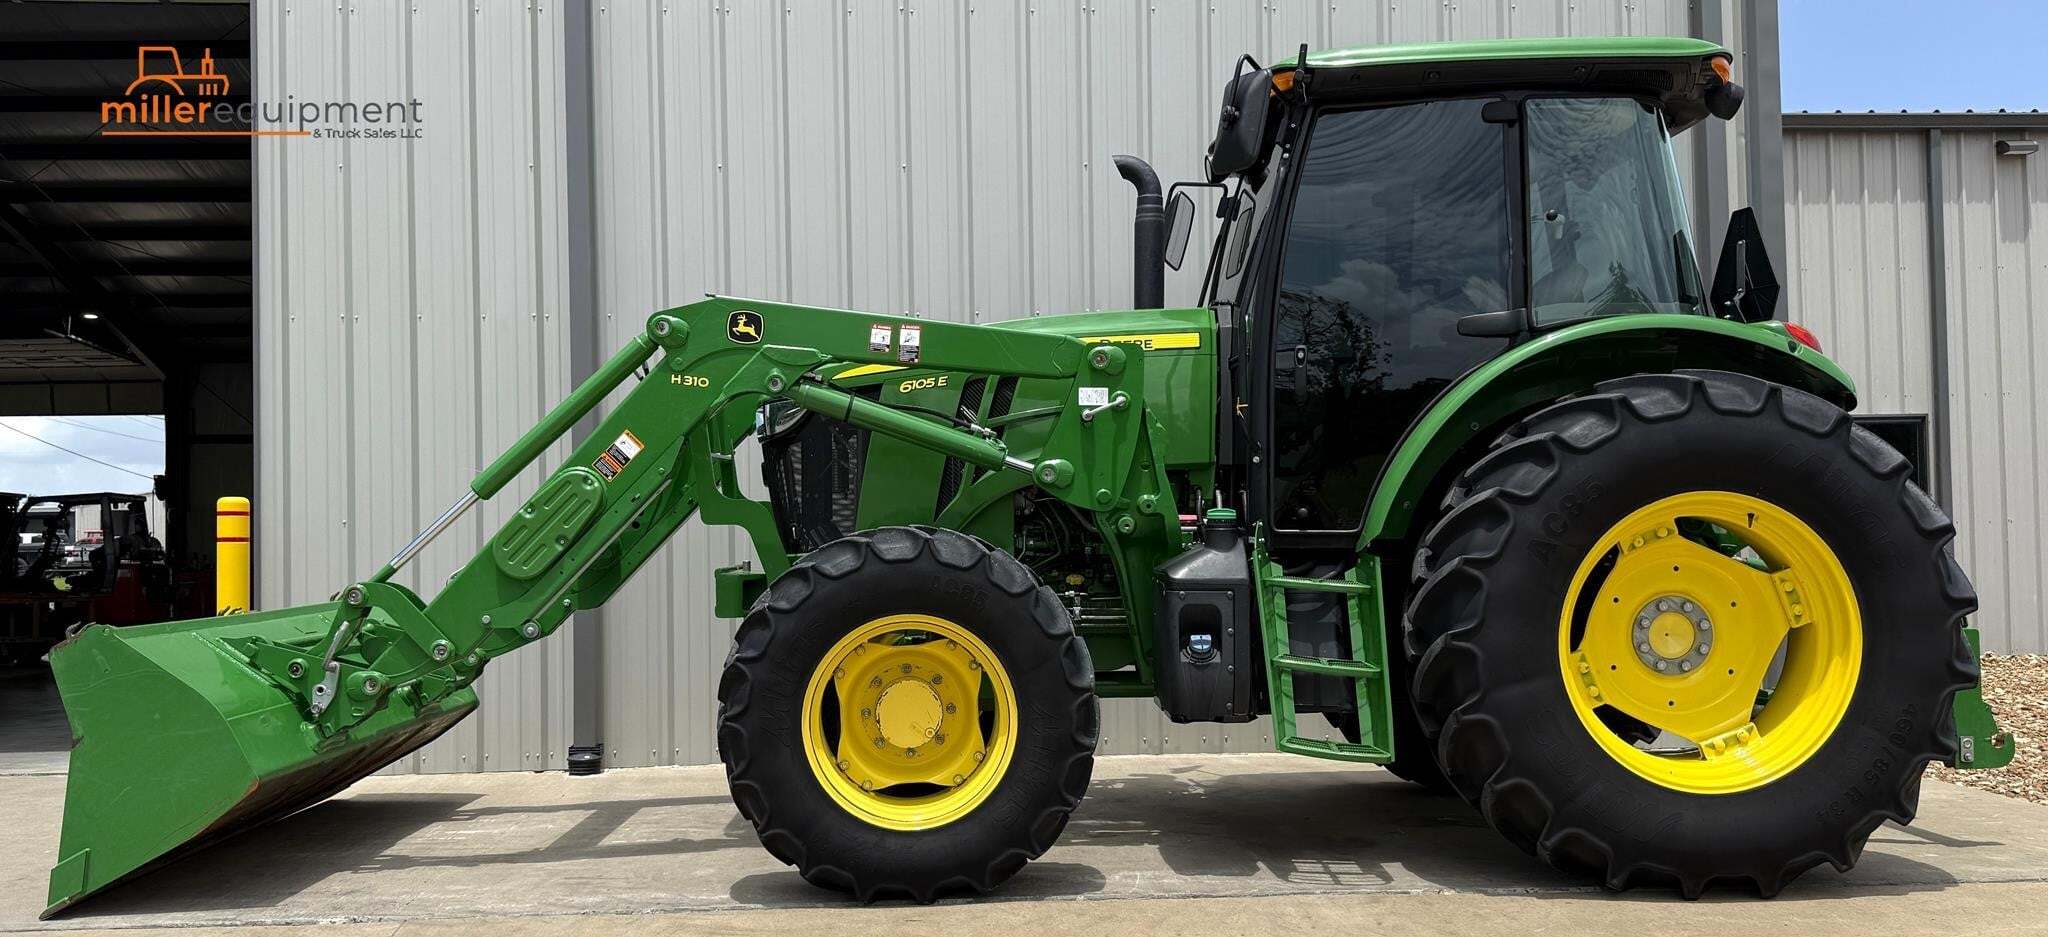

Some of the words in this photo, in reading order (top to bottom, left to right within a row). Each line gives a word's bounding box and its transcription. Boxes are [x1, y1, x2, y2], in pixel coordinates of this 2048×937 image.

[671, 374, 681, 385] H
[683, 375, 710, 388] 310
[900, 377, 936, 393] 6105
[938, 376, 949, 387] E
